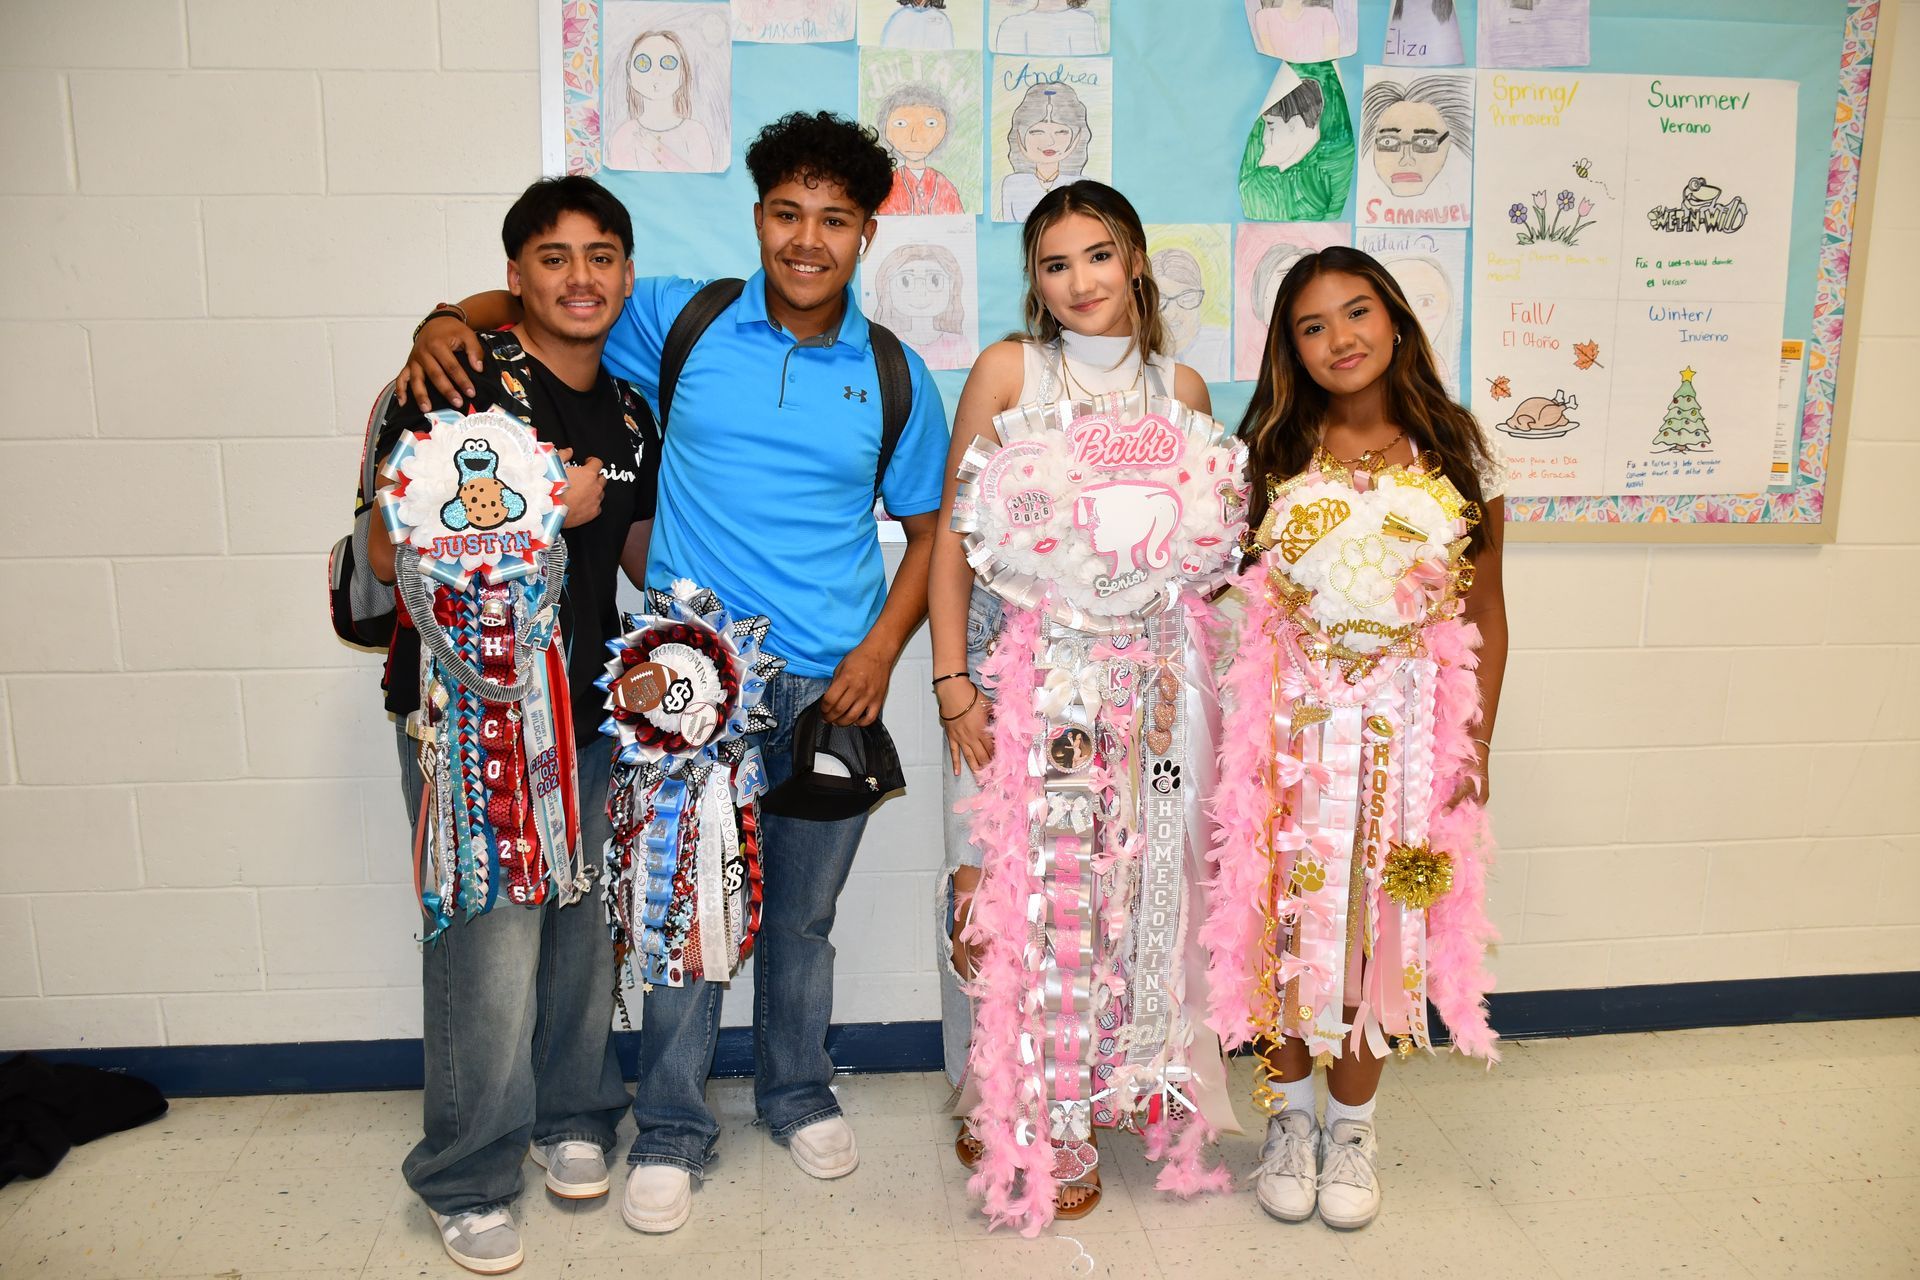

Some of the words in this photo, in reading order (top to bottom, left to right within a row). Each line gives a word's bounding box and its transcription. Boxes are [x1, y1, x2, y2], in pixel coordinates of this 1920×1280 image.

[1385, 28, 1428, 57] Eliza
[1003, 62, 1101, 92] Andrea
[1493, 75, 1580, 113] Spring/
[1648, 80, 1750, 110] Summer/
[1659, 117, 1712, 133] Verano
[1656, 260, 1662, 268] a
[1511, 302, 1555, 325] Fall/
[1649, 305, 1713, 322] Winter/
[1503, 330, 1515, 347] El
[1523, 331, 1560, 351] Otoño
[1679, 329, 1729, 343] Invierno
[1073, 421, 1178, 466] Barbie
[1012, 492, 1050, 509] CLASS
[1014, 507, 1049, 522] 2026
[430, 532, 532, 558] JUSTYN
[1094, 568, 1149, 597] Senior
[1327, 618, 1414, 639] HOMECOMING
[650, 643, 708, 690] HOMECOMING
[530, 746, 558, 774] CLAS
[537, 776, 558, 797] 202
[1367, 743, 1390, 869] ROSAS
[1145, 801, 1172, 1012] HOMECOMING
